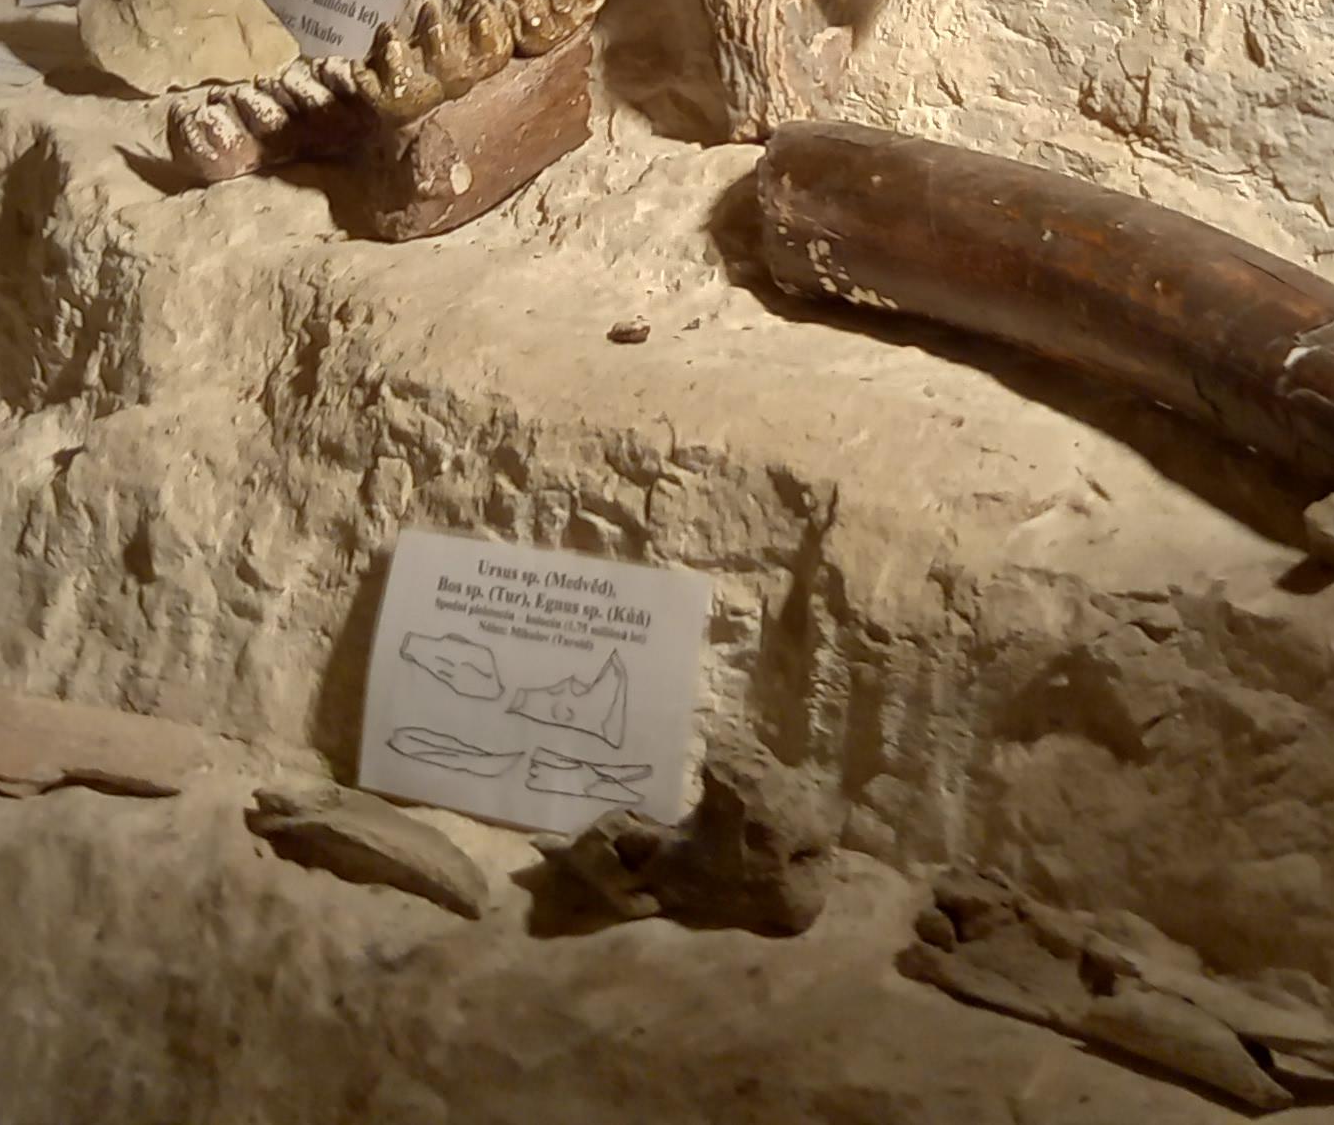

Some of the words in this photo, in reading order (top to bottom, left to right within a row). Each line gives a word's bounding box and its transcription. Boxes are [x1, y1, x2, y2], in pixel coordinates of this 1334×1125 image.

[300, 14, 346, 47] Mikulov
[356, 5, 380, 29] let)
[477, 559, 518, 581] Ursus
[522, 569, 541, 588] sp.
[437, 575, 462, 594] Bos
[465, 583, 485, 601] sp.
[582, 603, 604, 622] sp.
